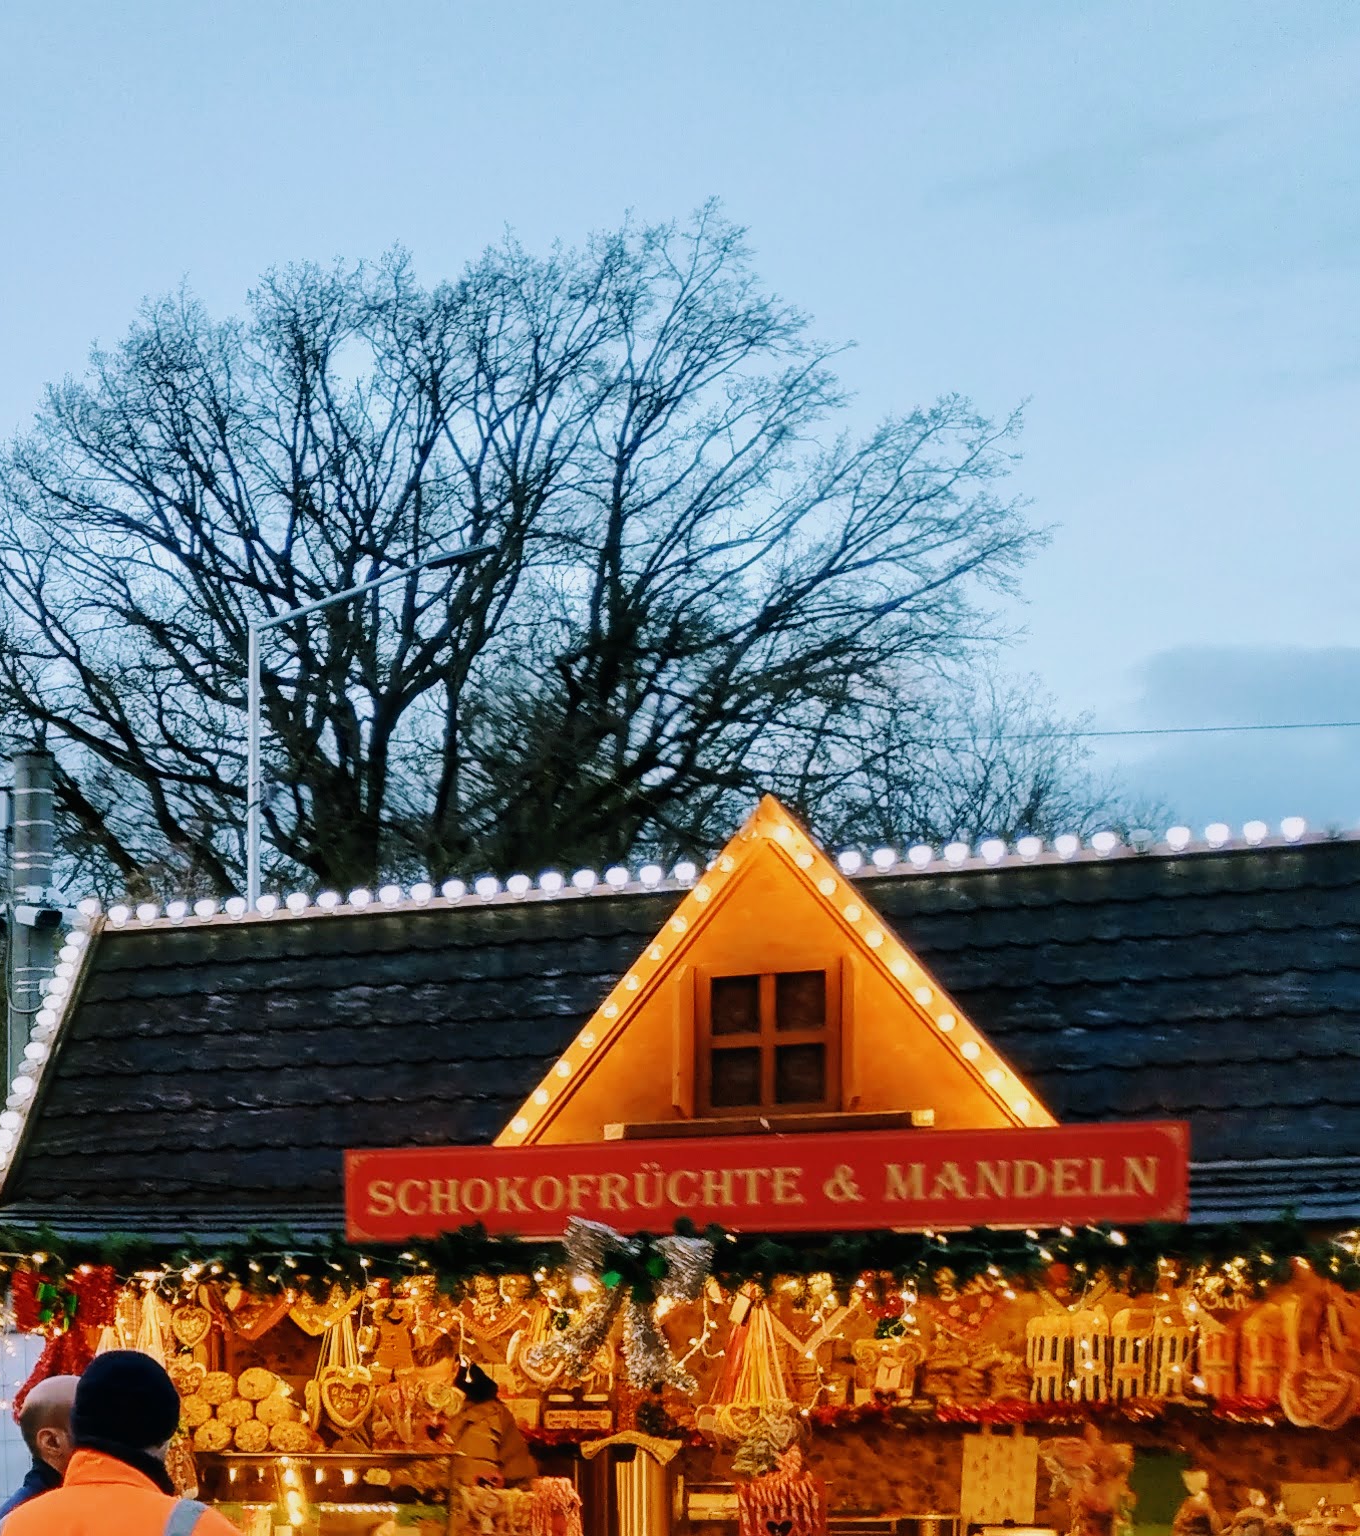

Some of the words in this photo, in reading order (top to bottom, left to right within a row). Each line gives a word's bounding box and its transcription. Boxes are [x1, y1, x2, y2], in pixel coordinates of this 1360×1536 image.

[366, 1162, 805, 1218] SCHOKOFRÜCHTE
[822, 1164, 863, 1203] &
[883, 1154, 1160, 1203] MANDELN
